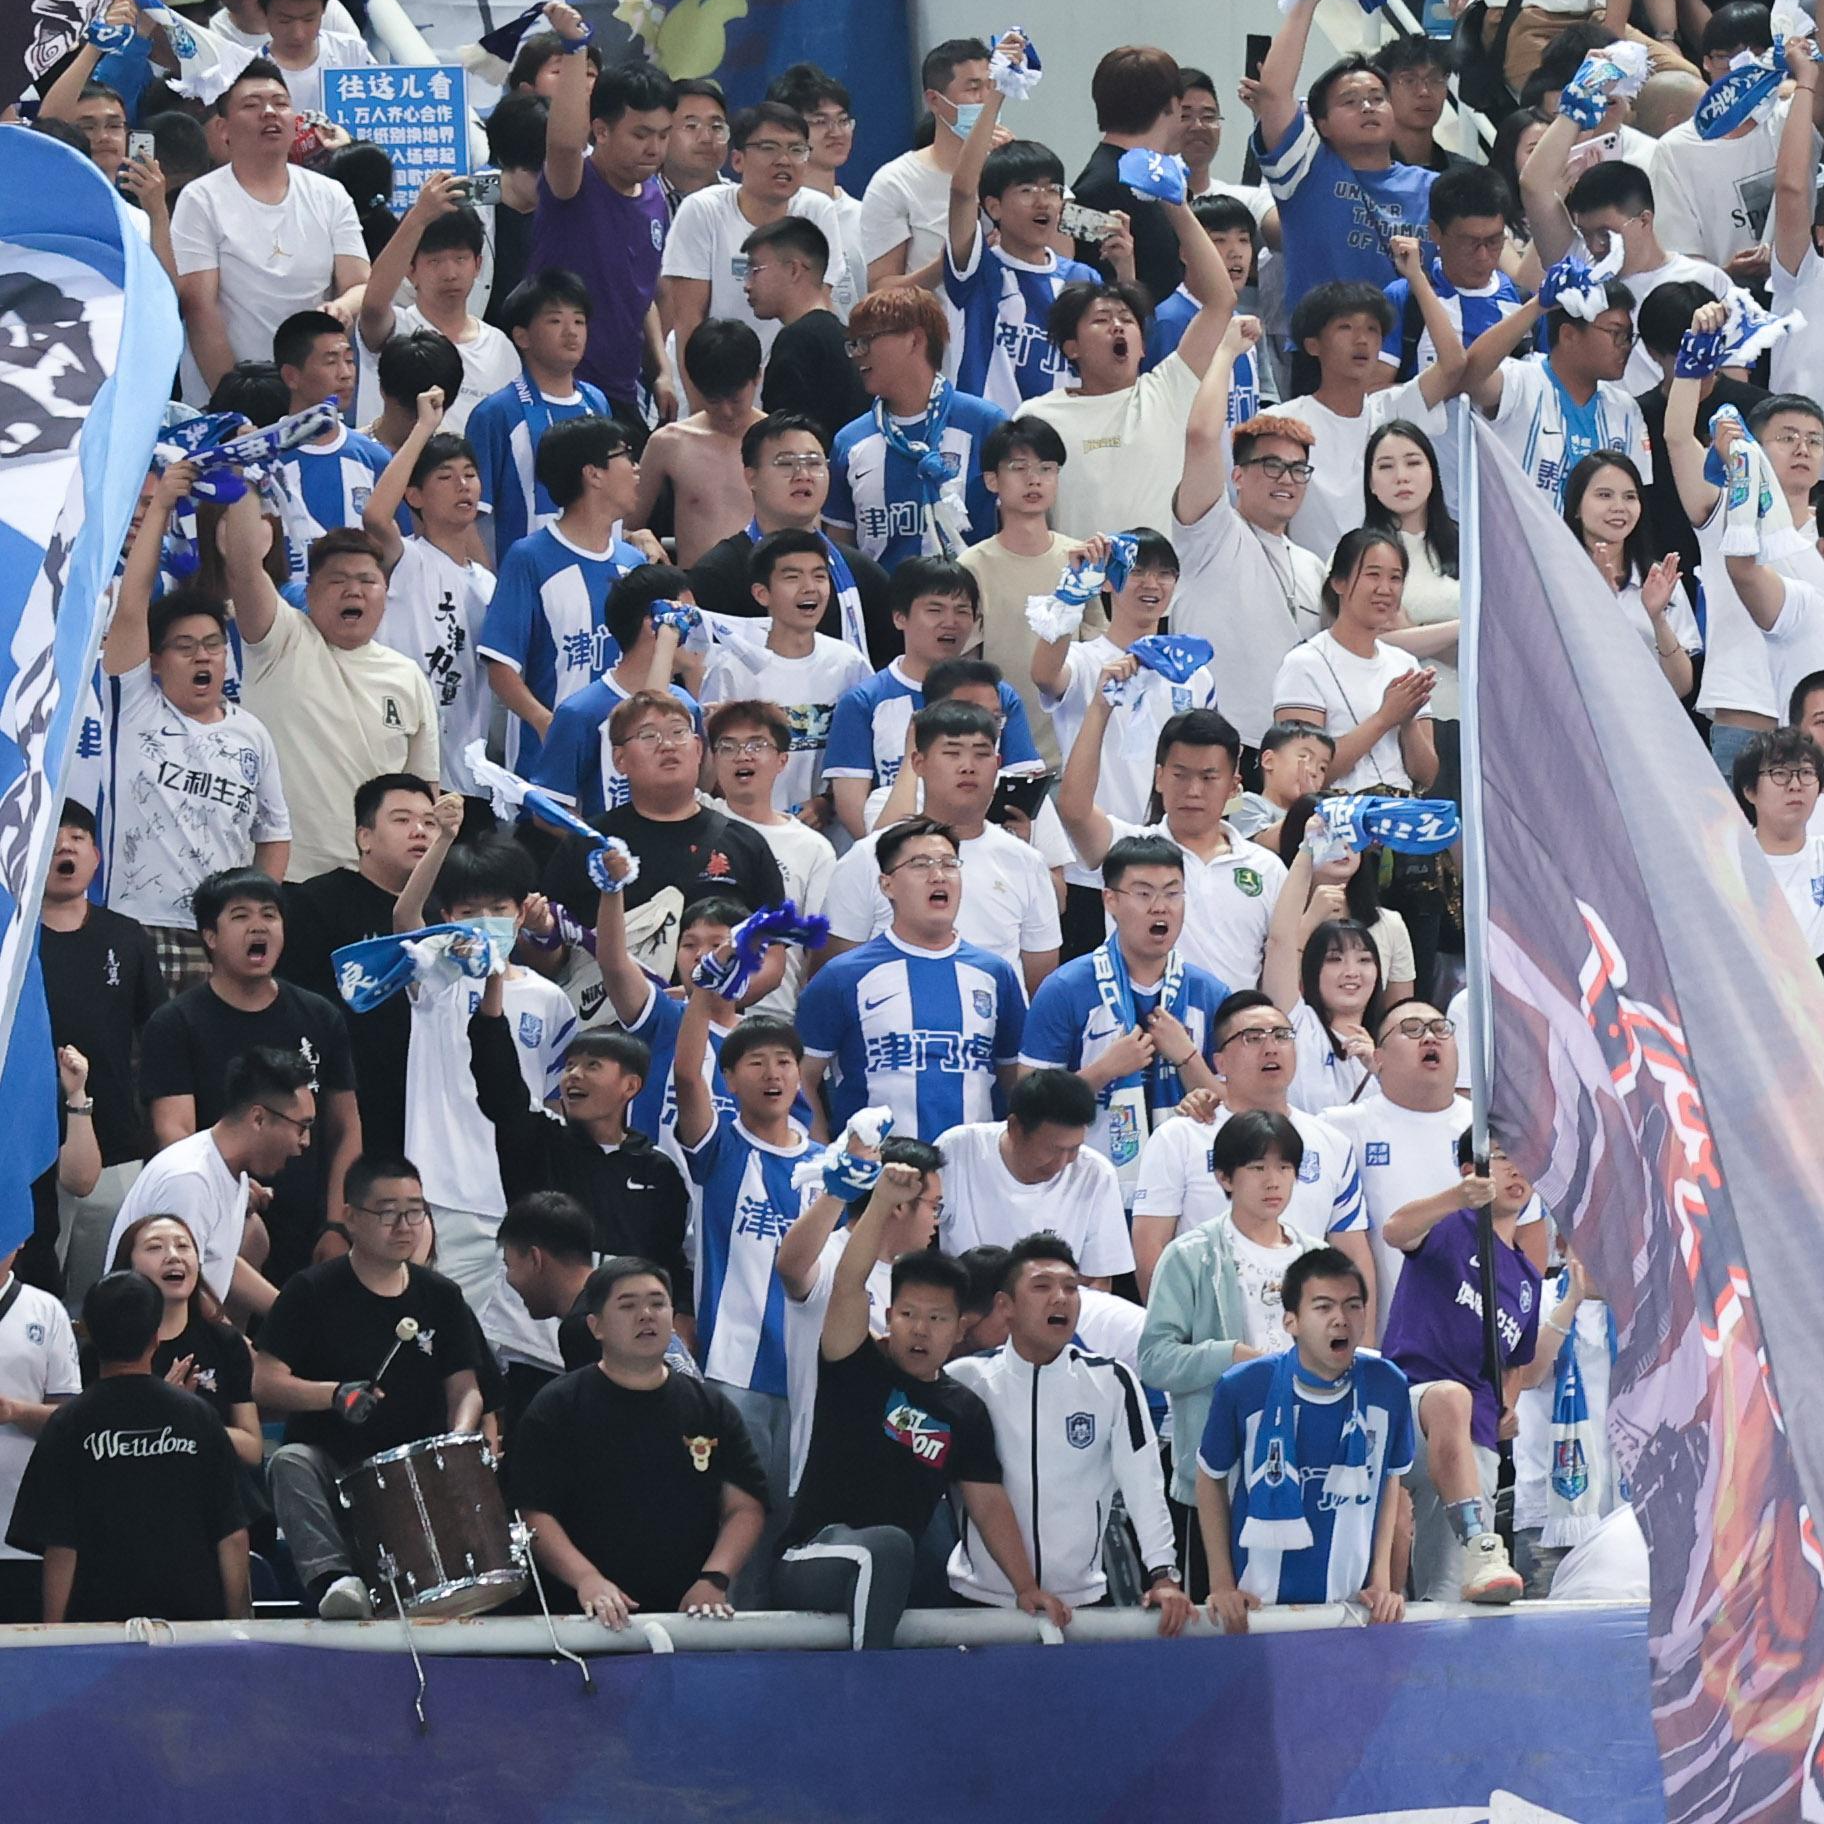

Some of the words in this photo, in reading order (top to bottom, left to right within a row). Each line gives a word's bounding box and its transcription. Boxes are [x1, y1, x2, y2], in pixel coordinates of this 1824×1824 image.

[337, 70, 453, 102] 往这儿看
[385, 696, 402, 727] A
[156, 758, 256, 815] 亿利生态
[580, 983, 605, 1007] NIK
[866, 1030, 995, 1074] 津门虎
[84, 1424, 199, 1461] Welldone
